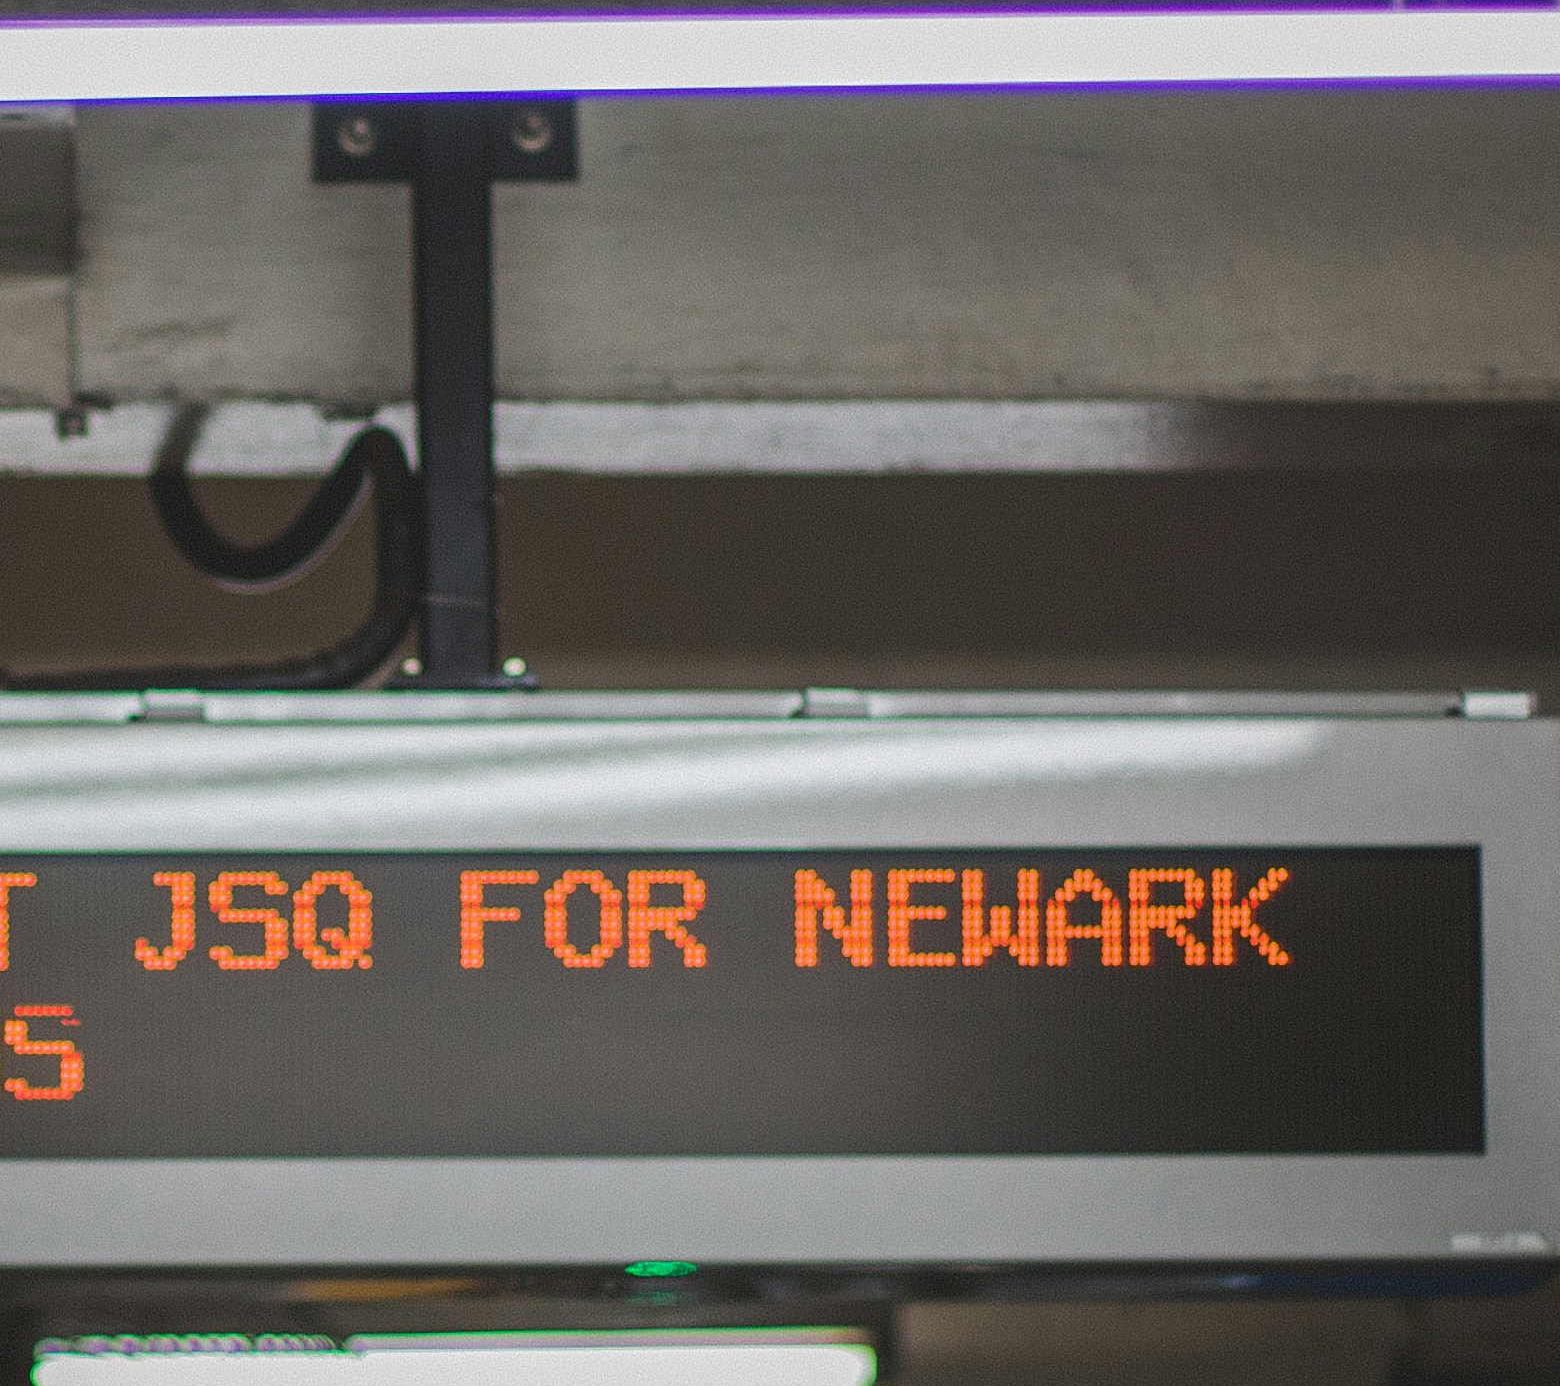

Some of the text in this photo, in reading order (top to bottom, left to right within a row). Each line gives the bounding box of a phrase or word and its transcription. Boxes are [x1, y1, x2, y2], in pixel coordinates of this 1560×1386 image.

[132, 869, 374, 973] JSQ
[458, 868, 709, 971] FOR
[792, 866, 1293, 970] NEWARK
